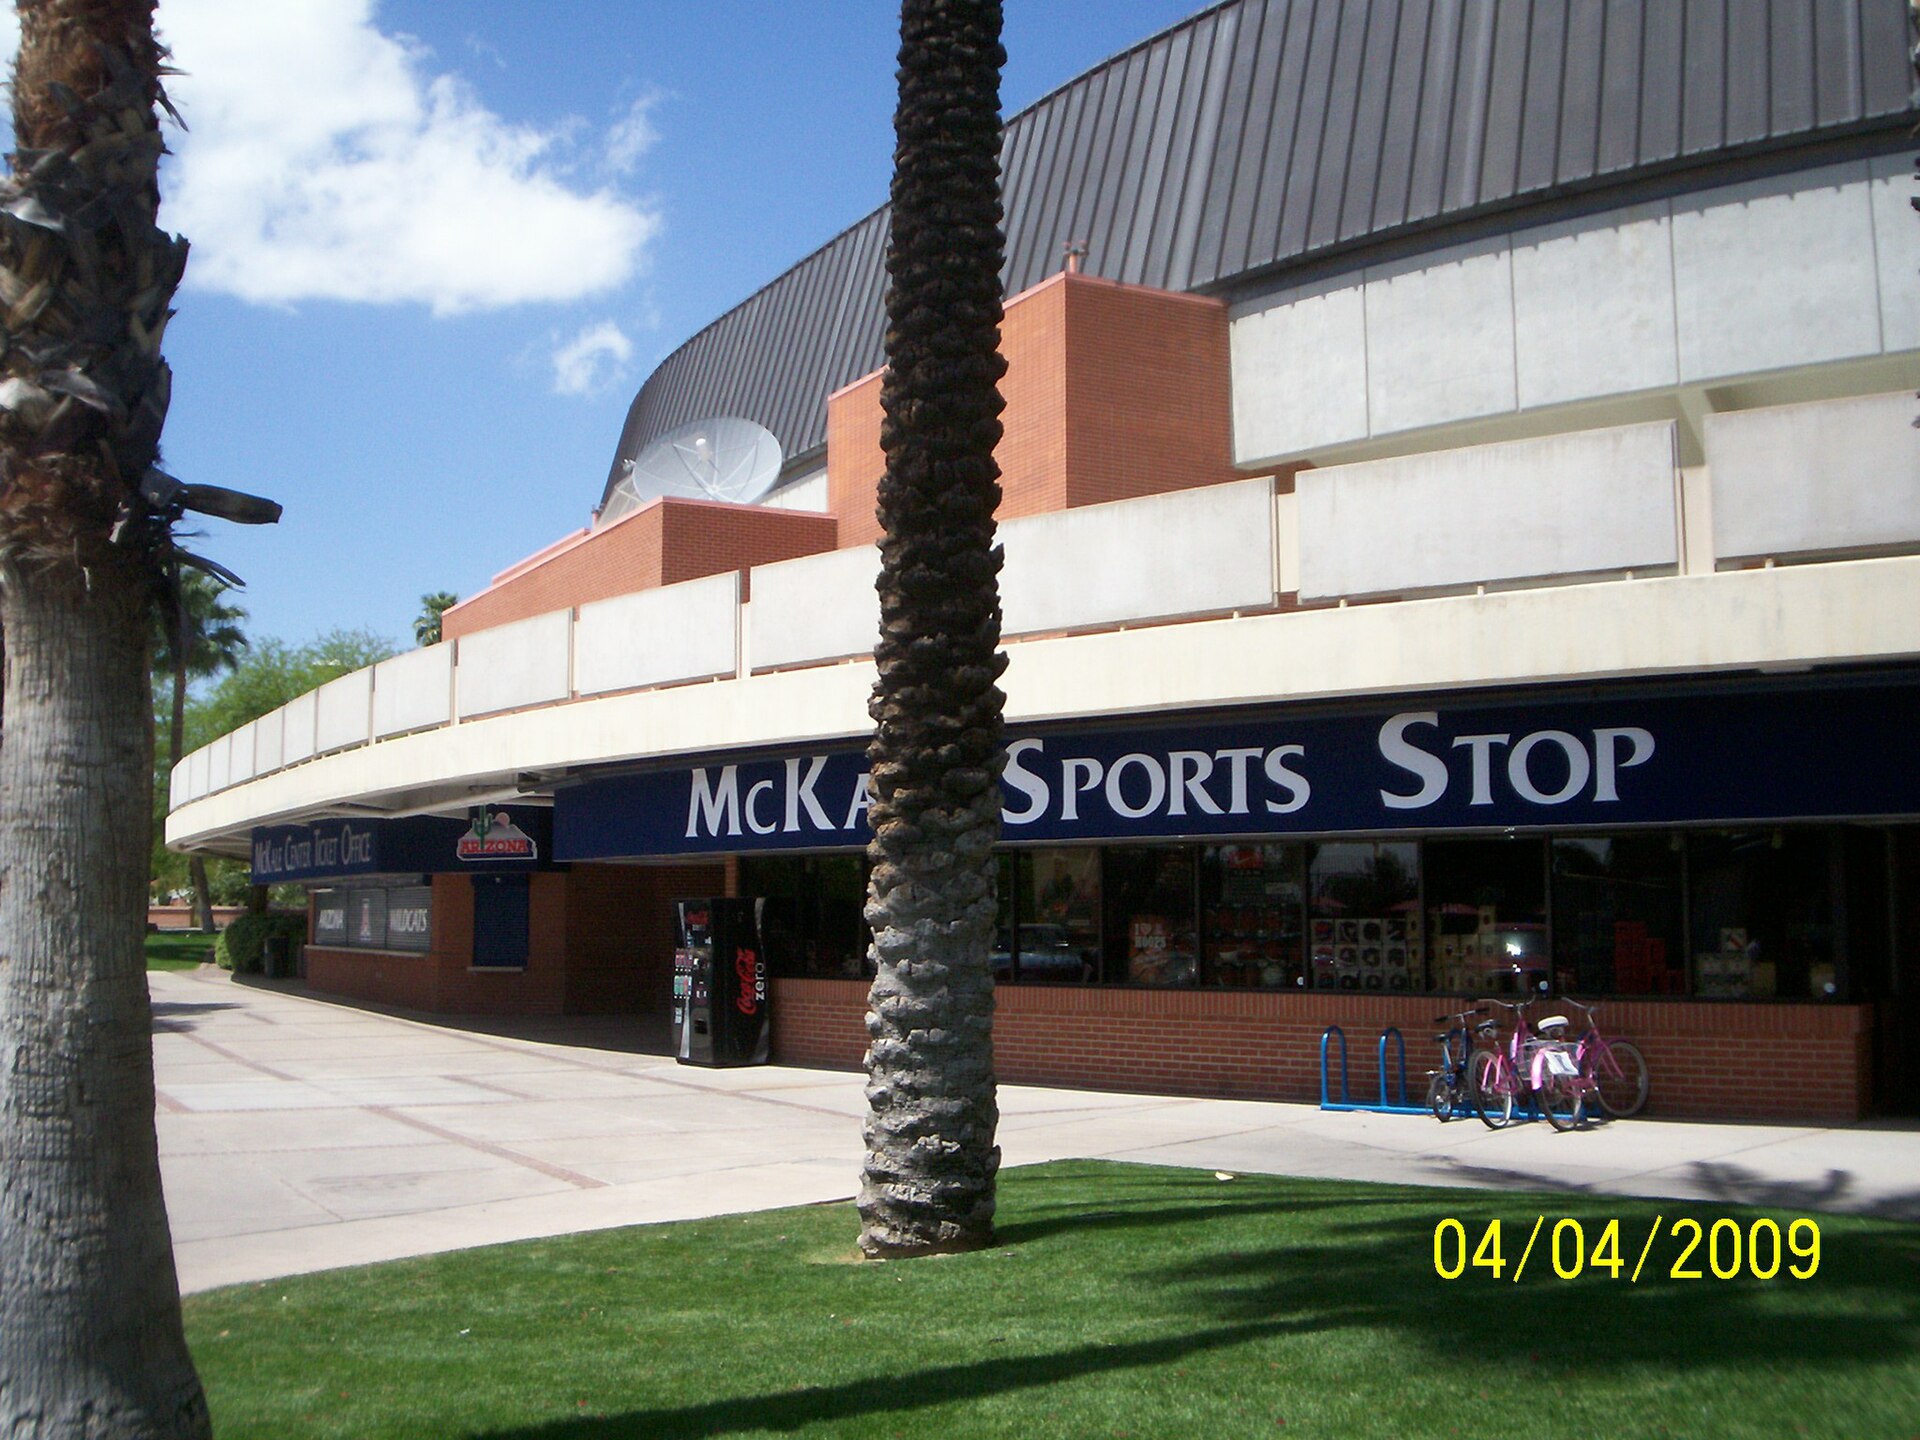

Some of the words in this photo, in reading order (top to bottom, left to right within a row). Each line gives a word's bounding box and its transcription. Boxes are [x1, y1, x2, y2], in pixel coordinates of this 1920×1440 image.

[685, 755, 877, 838] McKA
[460, 839, 529, 854] ARIZONA
[755, 962, 765, 1000] zero
